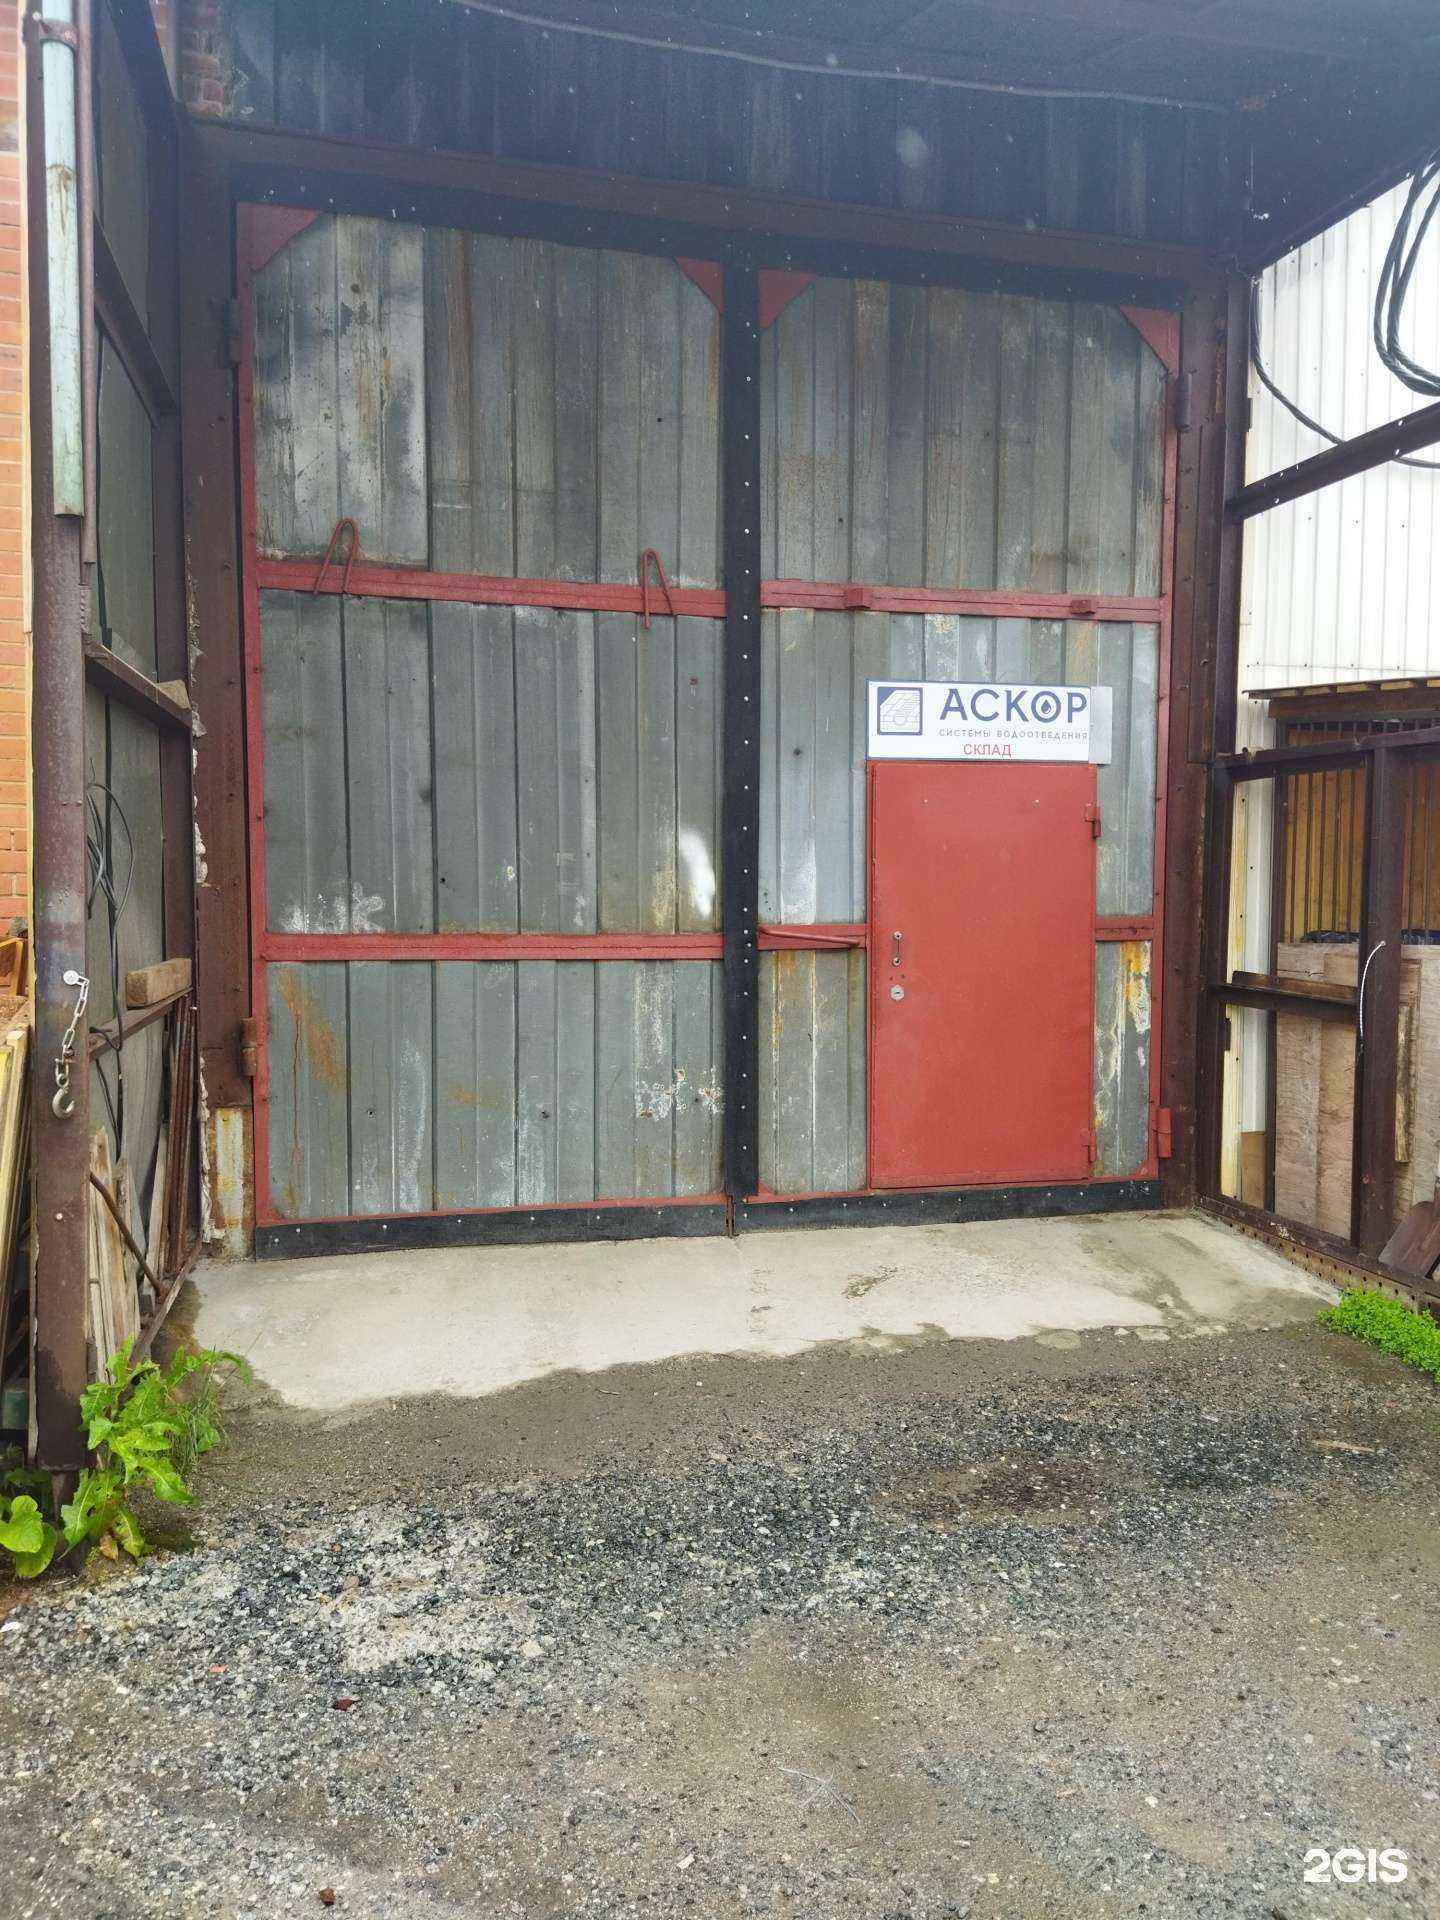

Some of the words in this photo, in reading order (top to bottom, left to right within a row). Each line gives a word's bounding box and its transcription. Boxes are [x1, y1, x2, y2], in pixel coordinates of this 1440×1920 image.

[939, 688, 1088, 724] АСКОР
[938, 728, 991, 738] СИСТЕМЫ
[996, 730, 1088, 741] ВОДООТВЕДЕНИЯ
[963, 743, 1012, 758] СКЛАД
